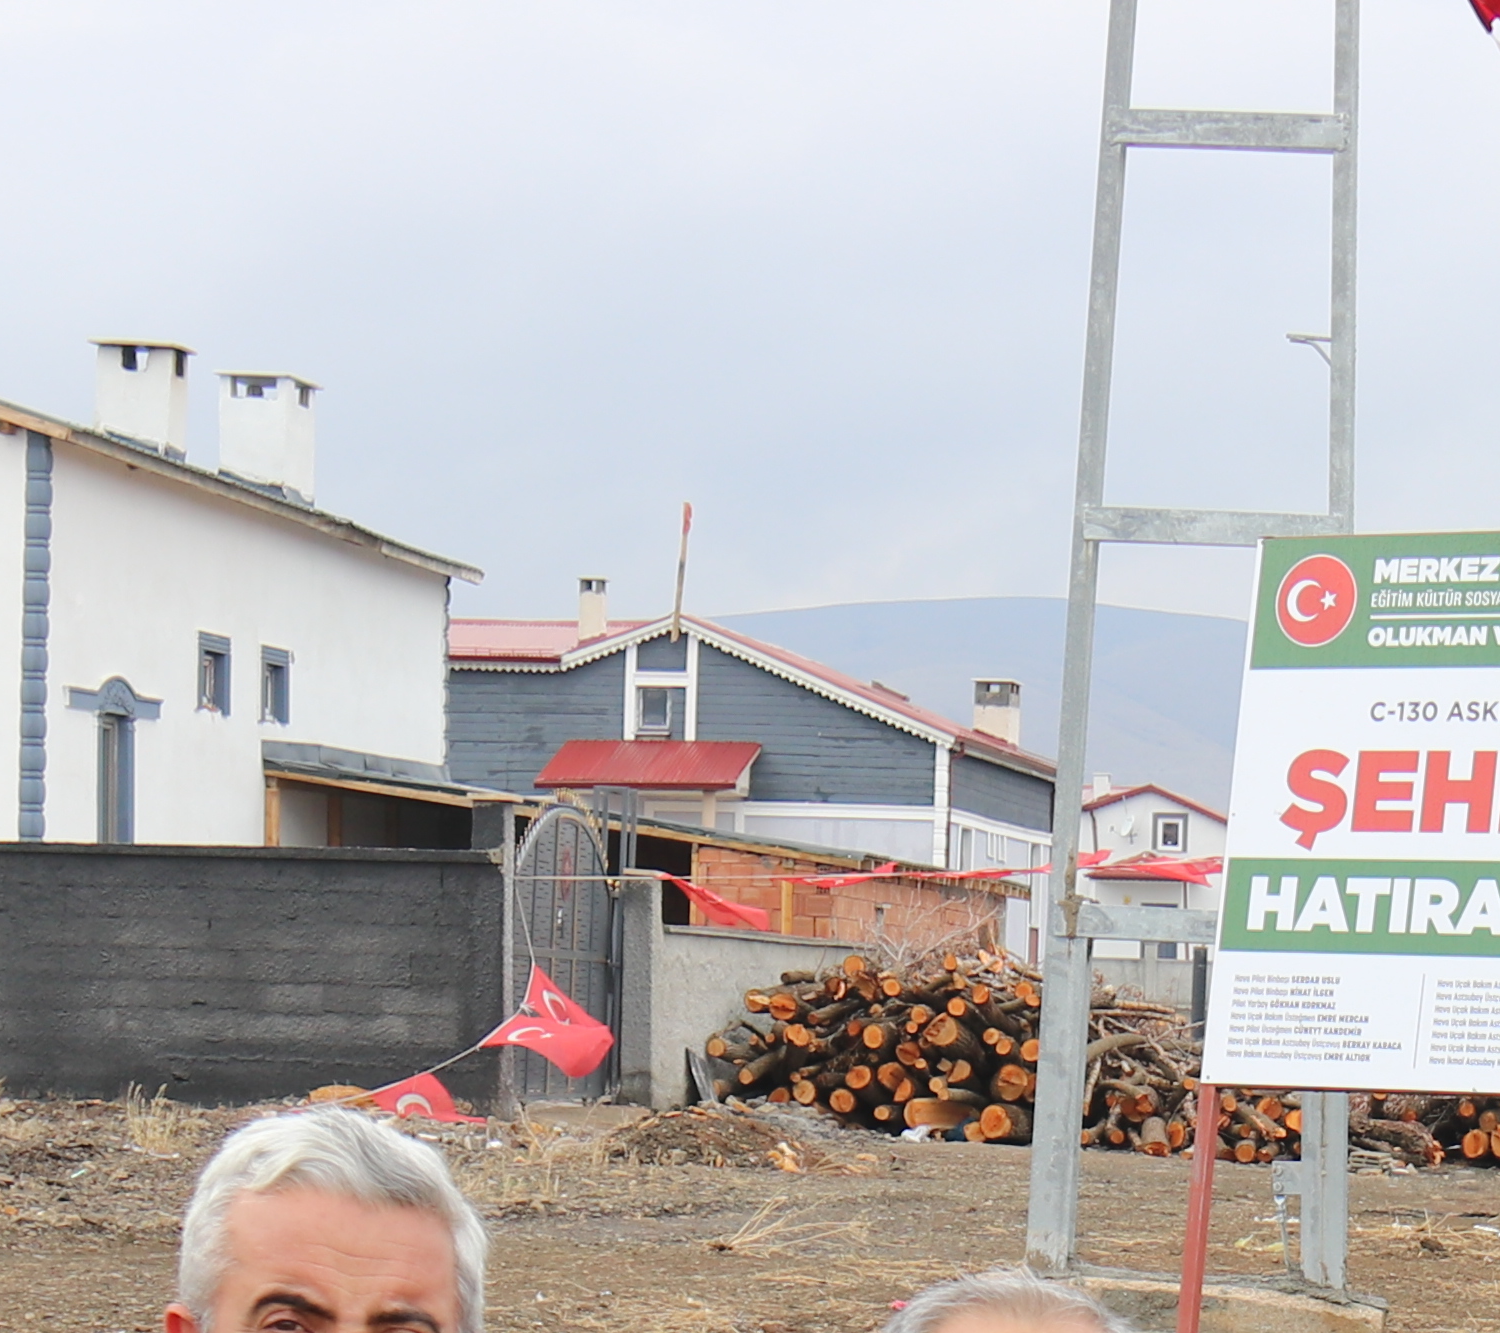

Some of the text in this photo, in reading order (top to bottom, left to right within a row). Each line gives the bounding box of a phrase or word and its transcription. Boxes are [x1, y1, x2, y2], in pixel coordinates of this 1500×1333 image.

[1373, 556, 1500, 584] MERKEZ
[1370, 588, 1413, 608] EĞİTİM
[1416, 587, 1463, 607] KÜLTÜR
[1367, 624, 1488, 648] OLUKMAN
[1370, 701, 1439, 723] C-130
